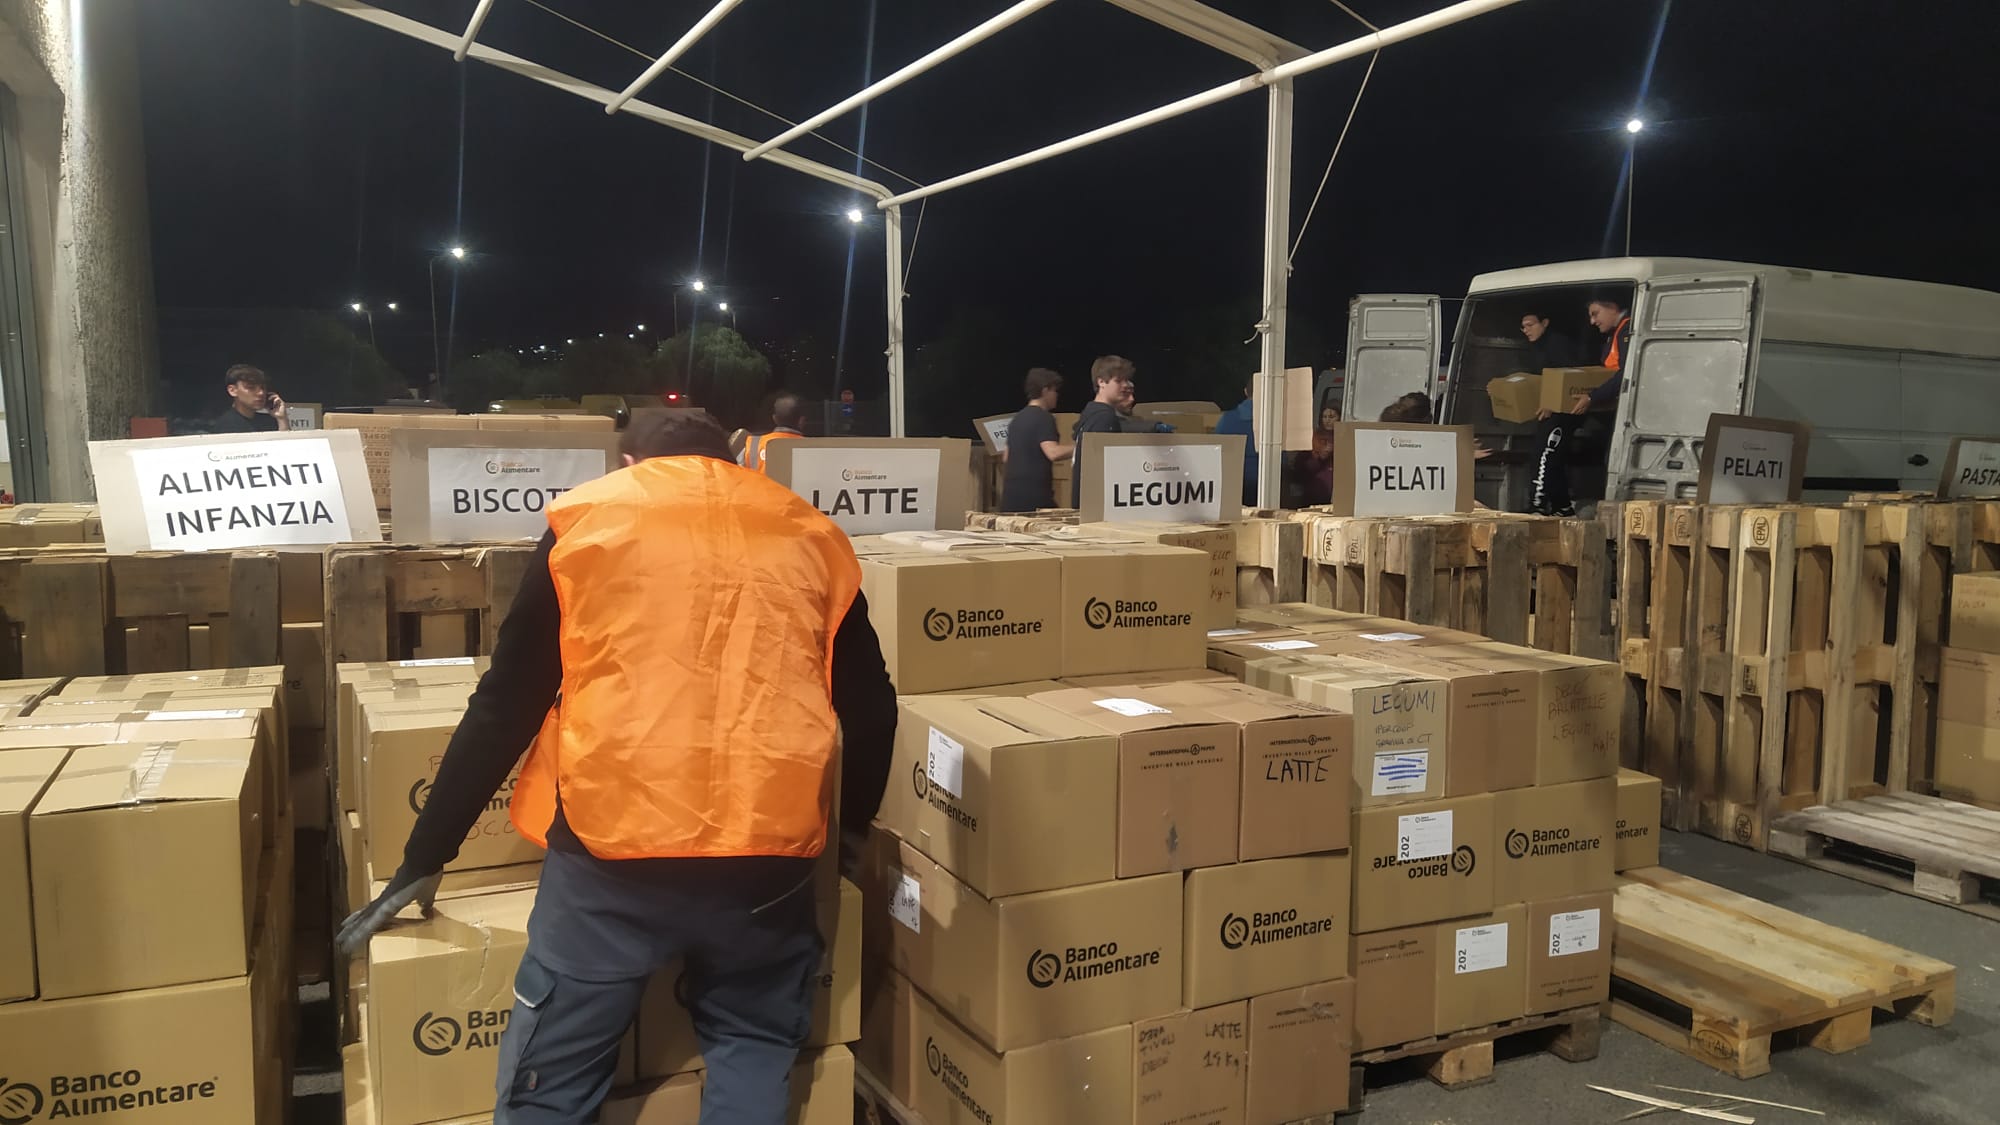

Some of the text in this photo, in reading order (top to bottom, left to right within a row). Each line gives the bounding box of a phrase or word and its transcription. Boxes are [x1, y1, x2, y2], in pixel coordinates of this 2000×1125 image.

[225, 452, 268, 461] Alimentare
[1724, 457, 1783, 479] PELATI
[159, 463, 323, 496] ALIMENTI
[1369, 465, 1445, 490] PELATI
[453, 487, 573, 514] BISCOT
[812, 487, 918, 516] LATTE
[1113, 481, 1214, 507] LEGUMI
[166, 500, 334, 537] INFANZIA
[1755, 522, 1767, 541] EPAL
[957, 608, 1004, 623] Banco
[1115, 600, 1157, 613] Banco
[956, 619, 1043, 639] Alimentare
[1114, 612, 1191, 628] Alimentare
[1372, 690, 1436, 715] LEGUMI
[928, 752, 936, 778] 202
[1266, 755, 1333, 783] LATTE
[928, 791, 977, 832] Alimentare
[1401, 835, 1410, 859] 202
[1531, 838, 1600, 856] Alimentare
[1532, 828, 1570, 842] Banco
[1409, 863, 1449, 879] Banco
[1253, 908, 1298, 928] Banco
[1251, 917, 1333, 946] Alimentare
[1552, 932, 1561, 955] 202
[1066, 942, 1118, 964] Banco
[1458, 948, 1467, 971] 202
[1064, 949, 1160, 983] Alimentare
[467, 1009, 512, 1030] Ban
[1205, 1022, 1242, 1040] LATTE
[51, 1069, 141, 1096] Banco
[943, 1053, 968, 1088] Banco
[49, 1080, 215, 1120] Alimentare
[942, 1071, 992, 1125] Alimentare
